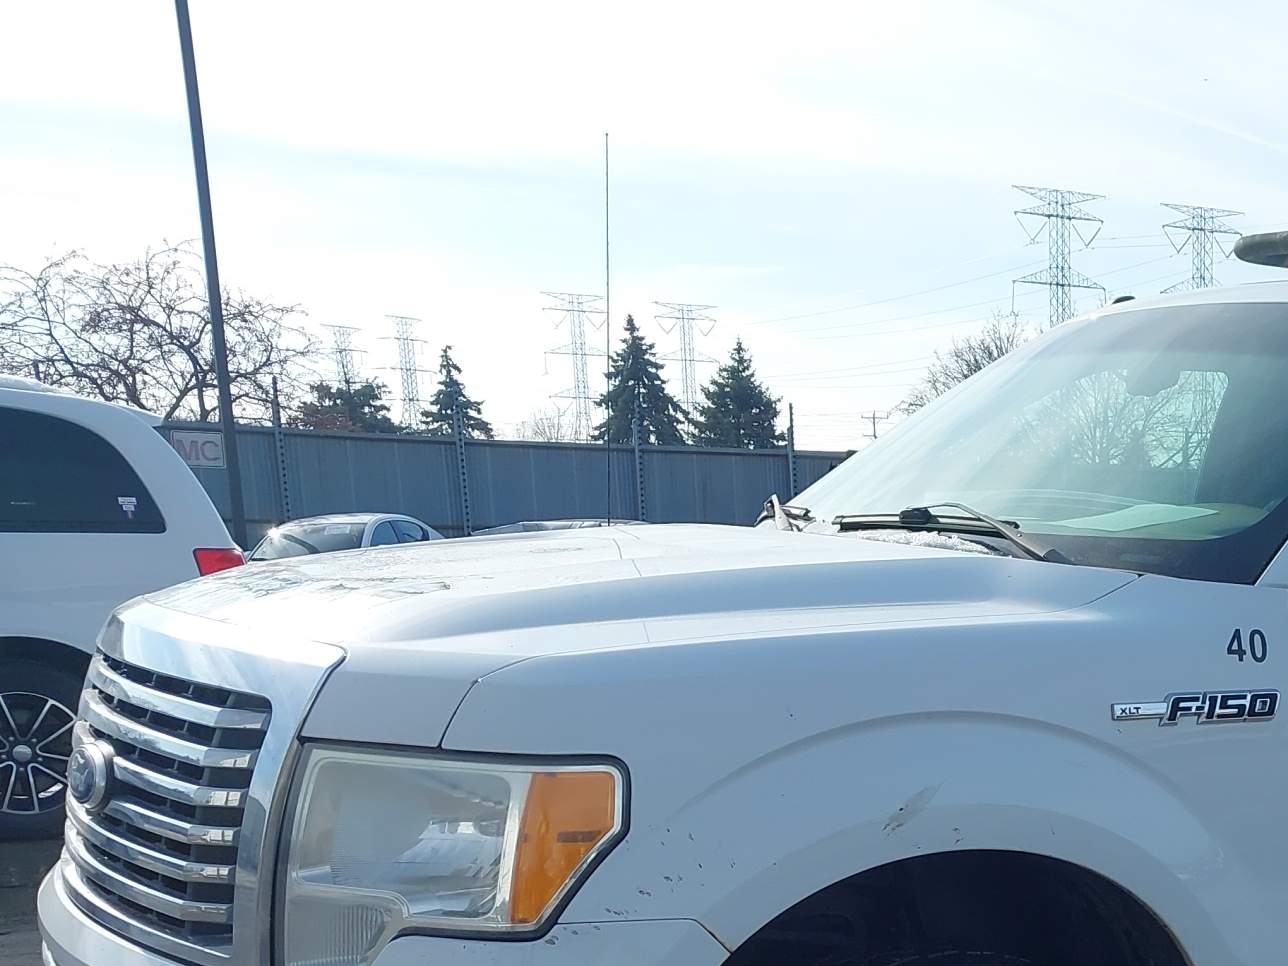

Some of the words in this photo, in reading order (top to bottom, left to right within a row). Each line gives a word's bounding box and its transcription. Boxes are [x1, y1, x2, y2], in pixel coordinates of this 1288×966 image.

[1226, 628, 1268, 663] 40
[1119, 706, 1142, 715] XLT
[1167, 692, 1279, 722] F-150
